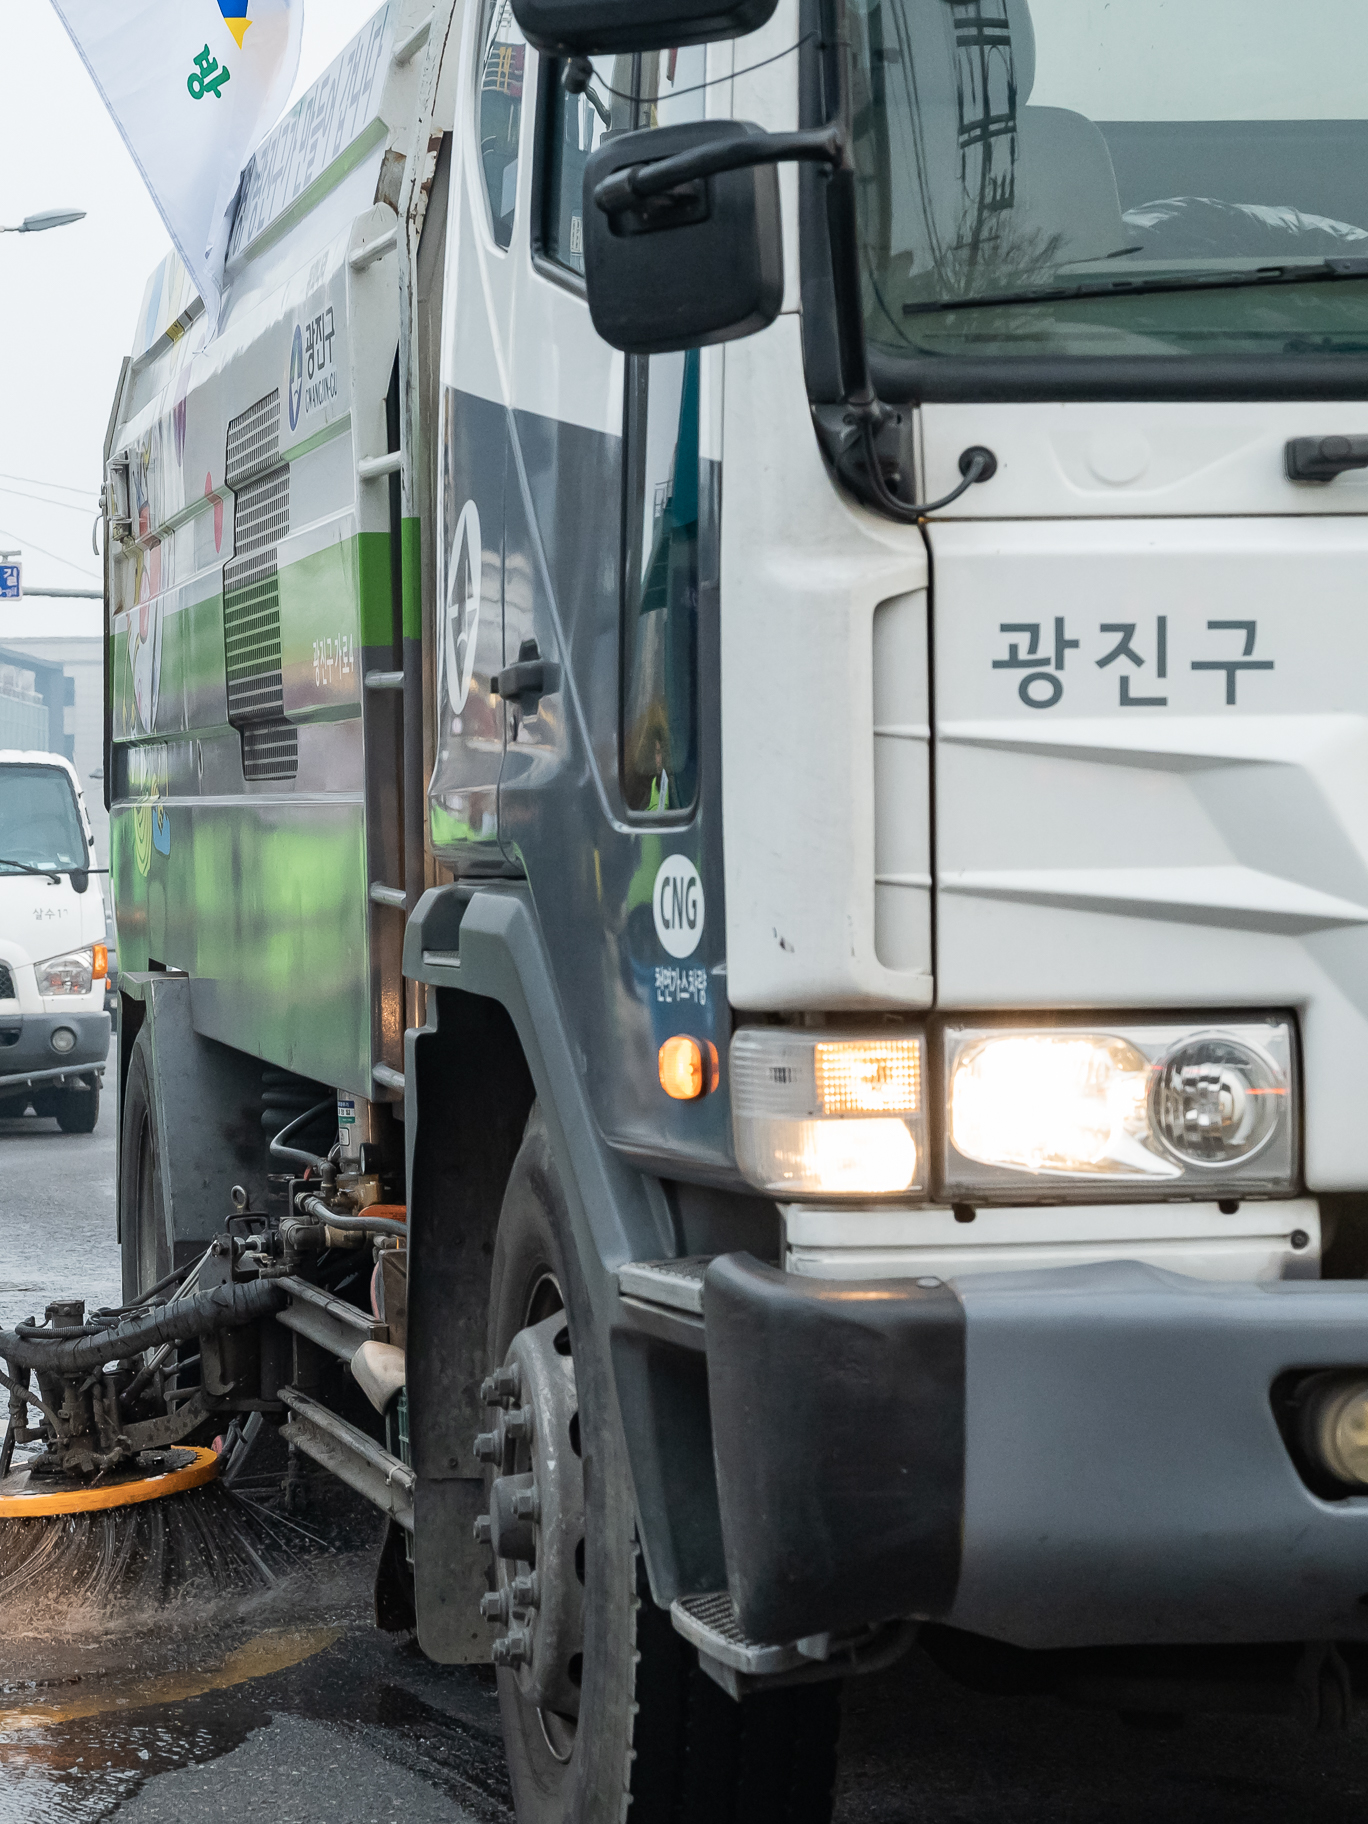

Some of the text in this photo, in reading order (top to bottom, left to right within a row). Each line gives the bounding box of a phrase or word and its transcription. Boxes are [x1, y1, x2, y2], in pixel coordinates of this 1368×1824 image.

[186, 43, 231, 100] 방
[305, 306, 335, 380] 광진구
[992, 615, 1275, 709] 광진구
[661, 876, 697, 930] CNG
